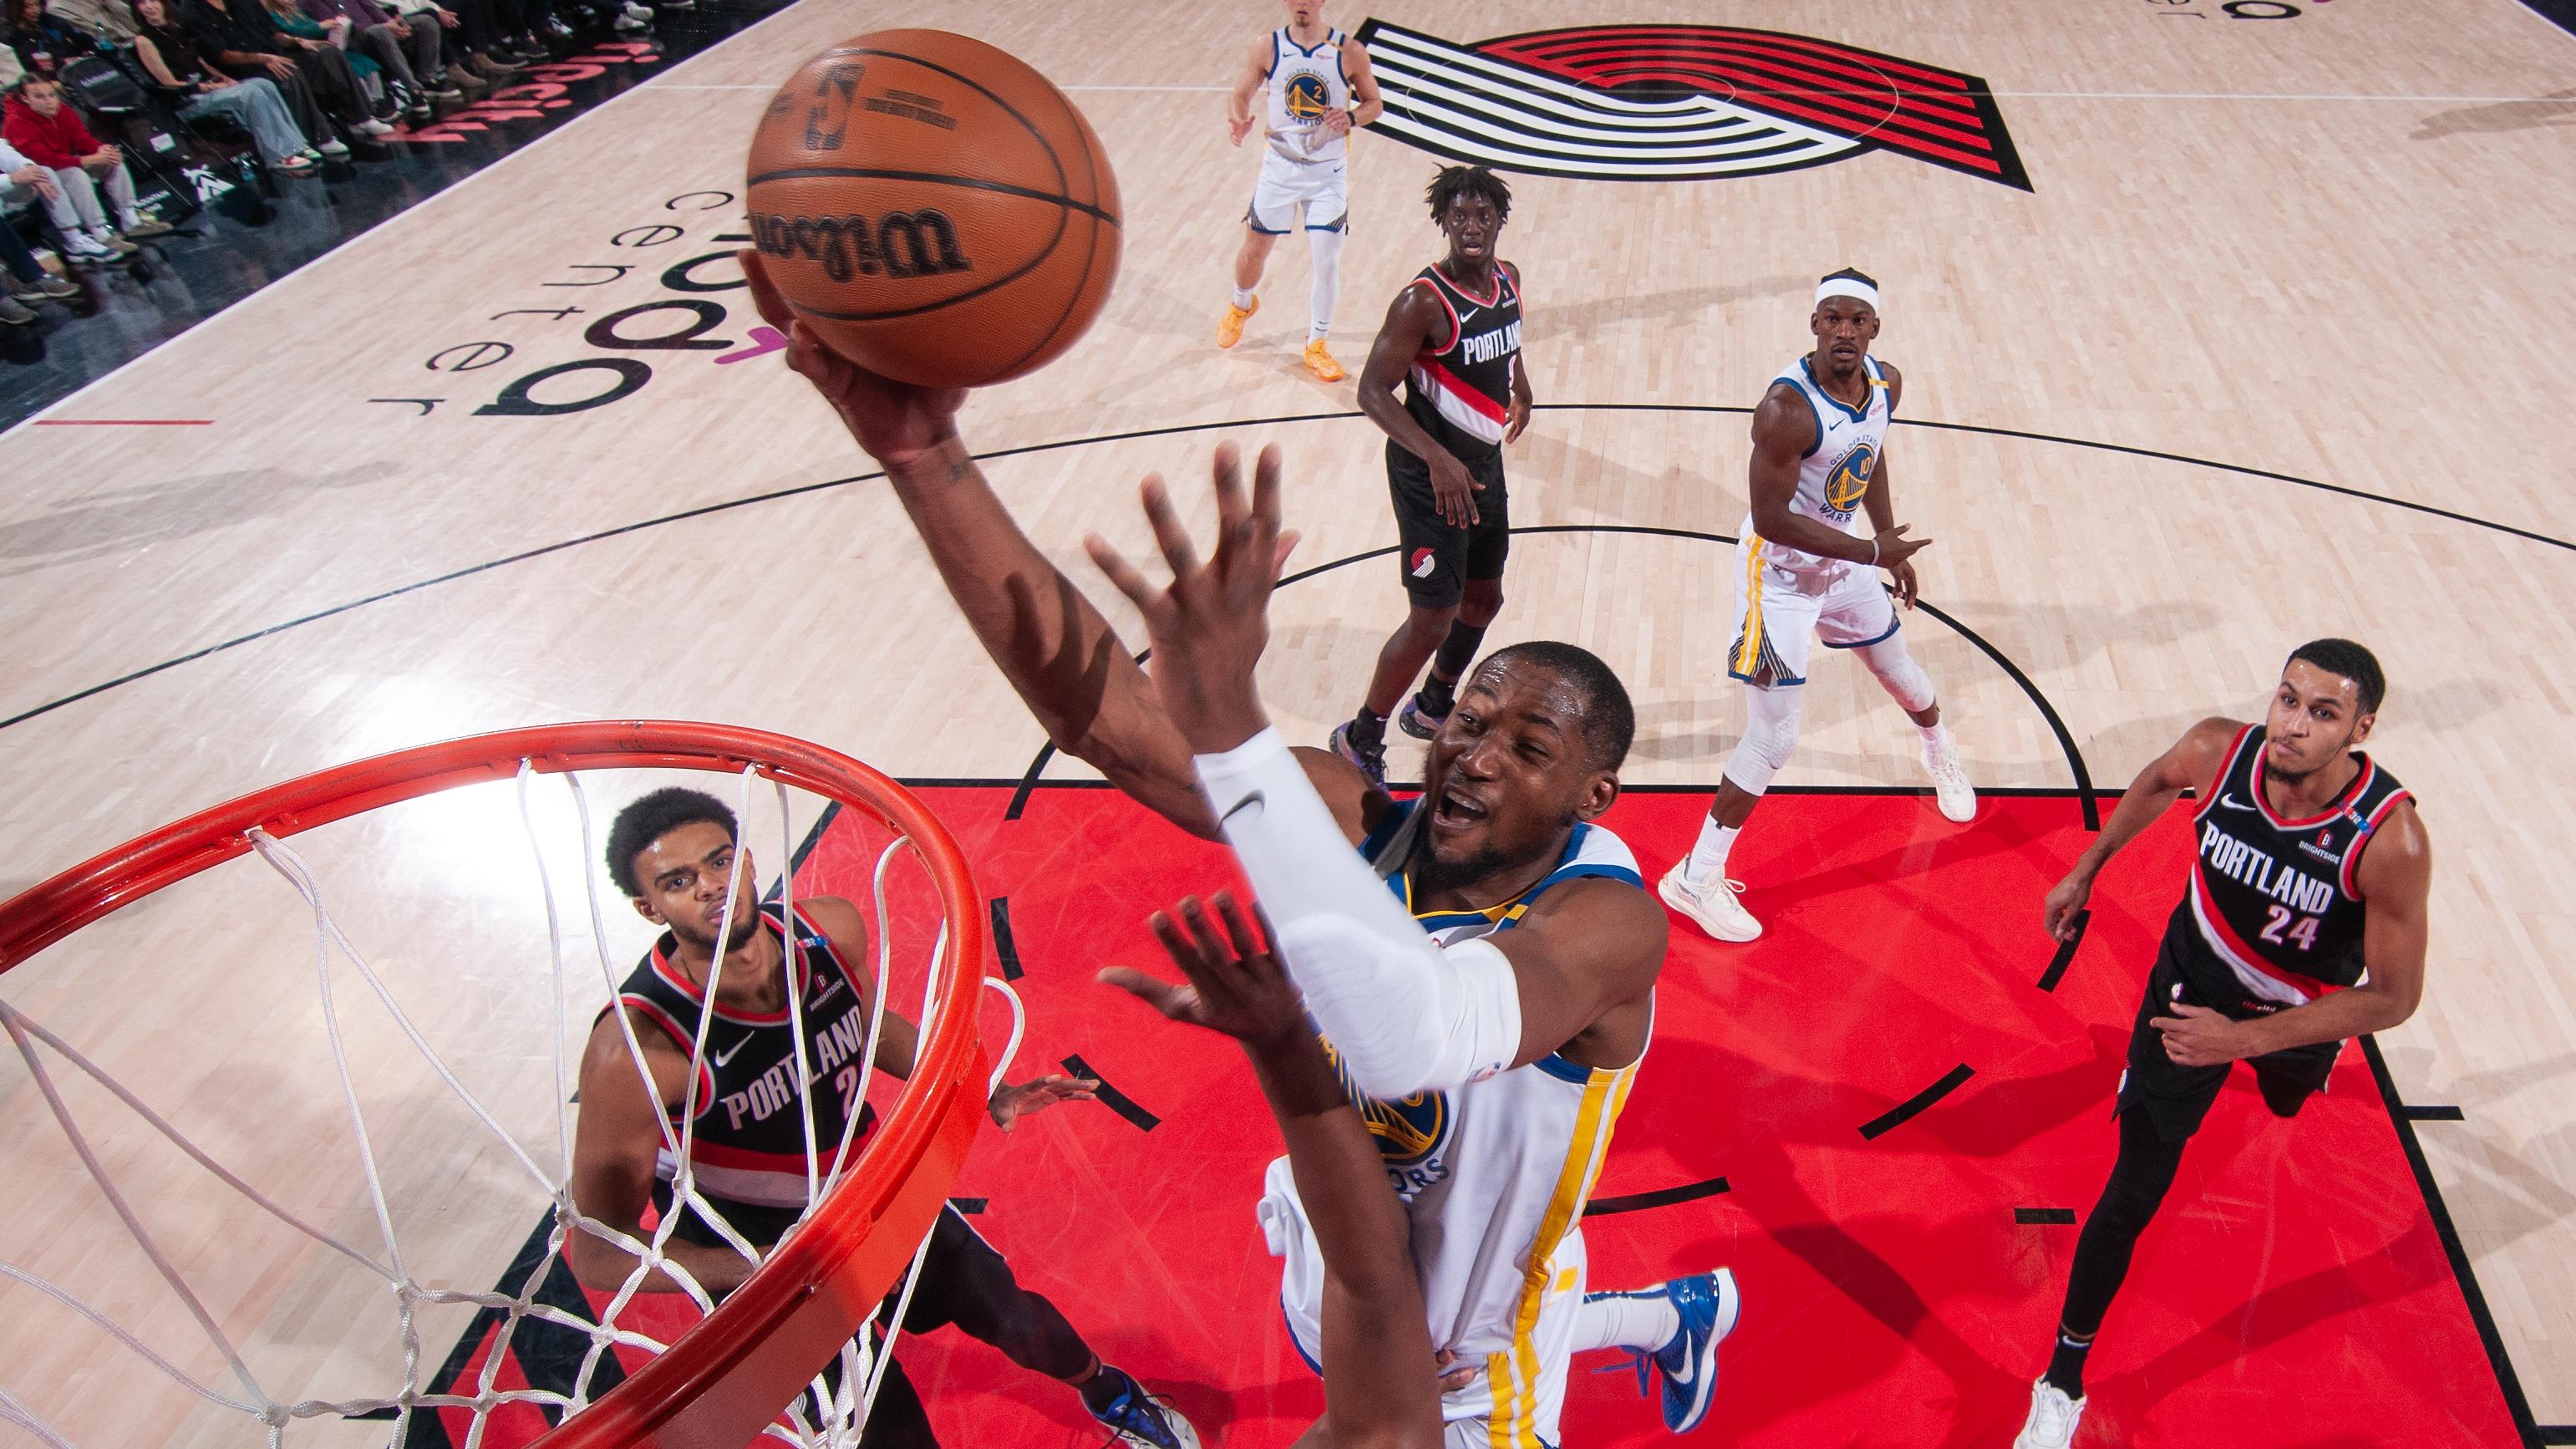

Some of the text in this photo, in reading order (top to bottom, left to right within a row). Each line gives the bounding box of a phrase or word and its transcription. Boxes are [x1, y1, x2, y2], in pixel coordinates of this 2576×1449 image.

[1313, 85, 1322, 99] 2
[368, 191, 734, 416] center
[472, 214, 757, 416] oda
[1461, 319, 1522, 365] PORTLAN
[1830, 434, 1878, 465] GOLDEN STATE
[2199, 820, 2335, 914] PORTLAND
[2299, 840, 2341, 865] BRIGHTSIDE
[2259, 904, 2321, 950] 24
[810, 977, 846, 1013] BRIGHTSIDE
